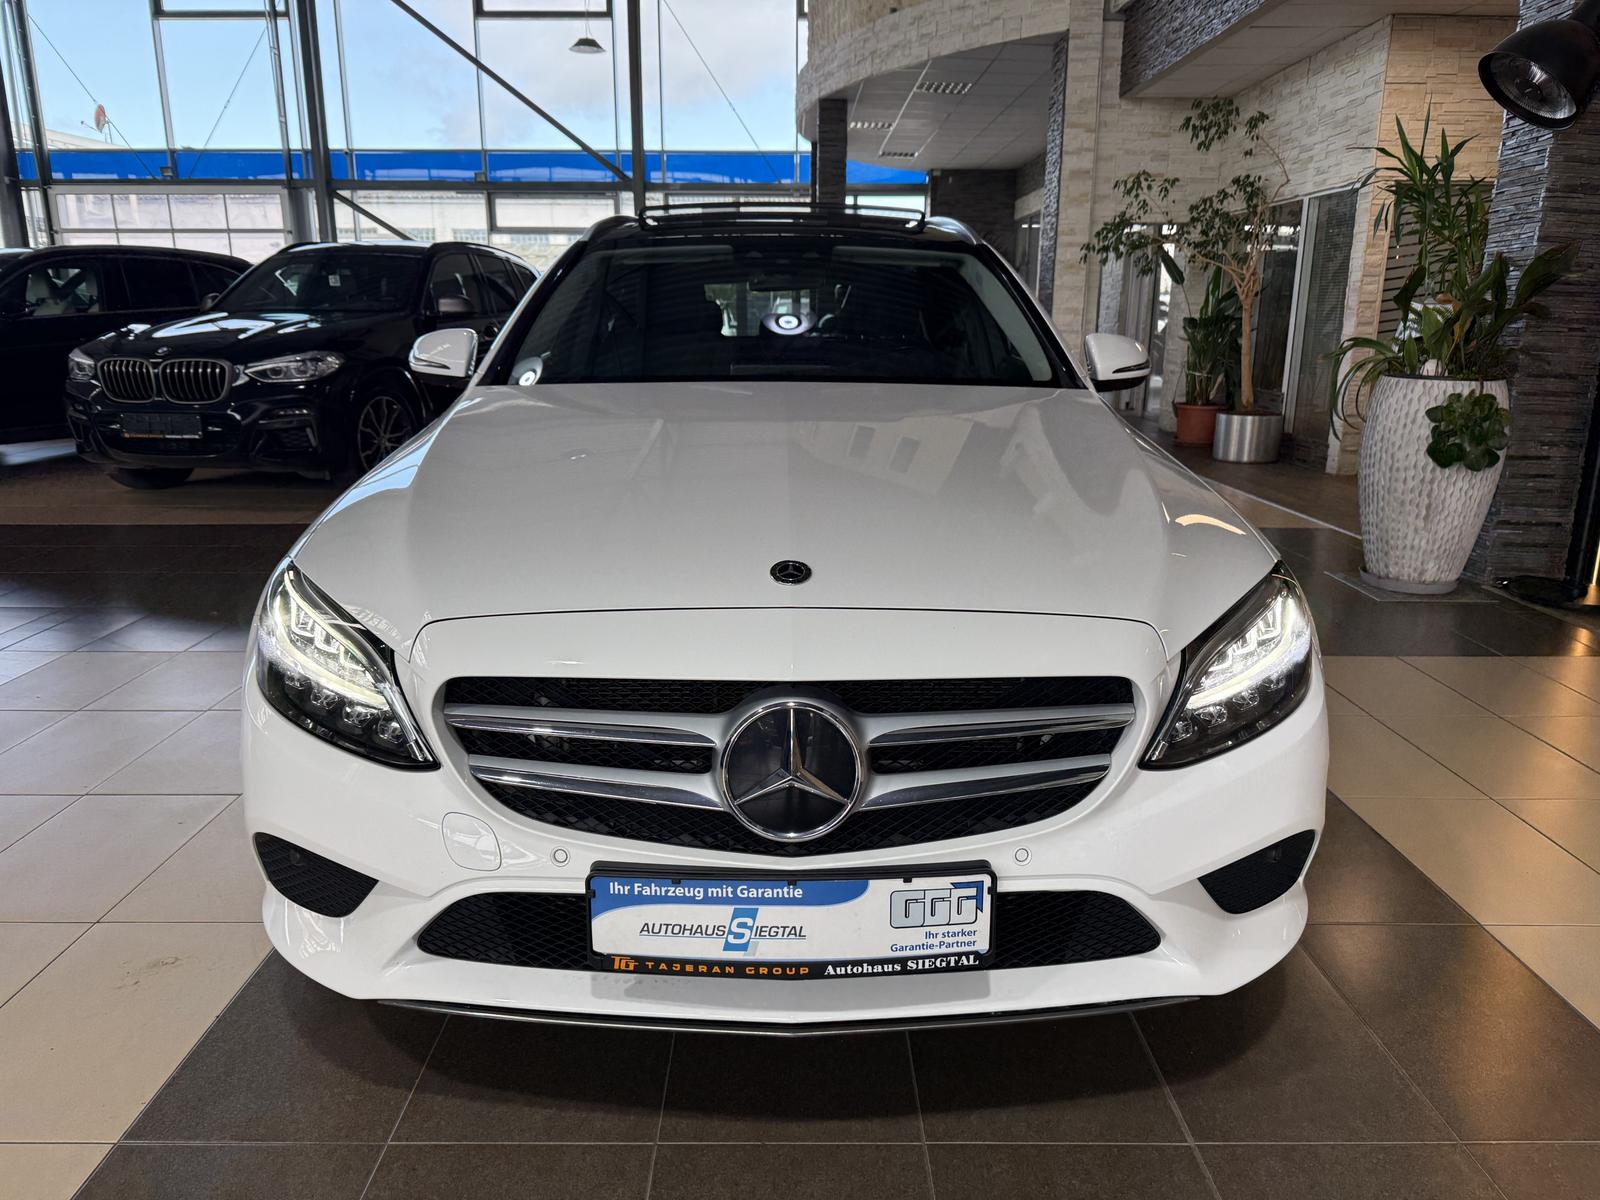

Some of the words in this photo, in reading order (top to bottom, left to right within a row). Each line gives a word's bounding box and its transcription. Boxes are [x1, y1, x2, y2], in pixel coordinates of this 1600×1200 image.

[609, 882, 630, 894] Ihr
[634, 883, 704, 900] Fahrzeug
[708, 885, 734, 898] mit
[736, 886, 803, 898] Garantie
[639, 922, 726, 937] AUTOHAUS
[925, 930, 939, 940] Ihr
[941, 928, 978, 939] starker
[890, 939, 977, 952] Garantie-Partner
[646, 962, 734, 974] TAJERAN
[746, 966, 808, 975] GROUP
[824, 962, 901, 976] Autohaus
[907, 954, 980, 970] SIEGTAL
